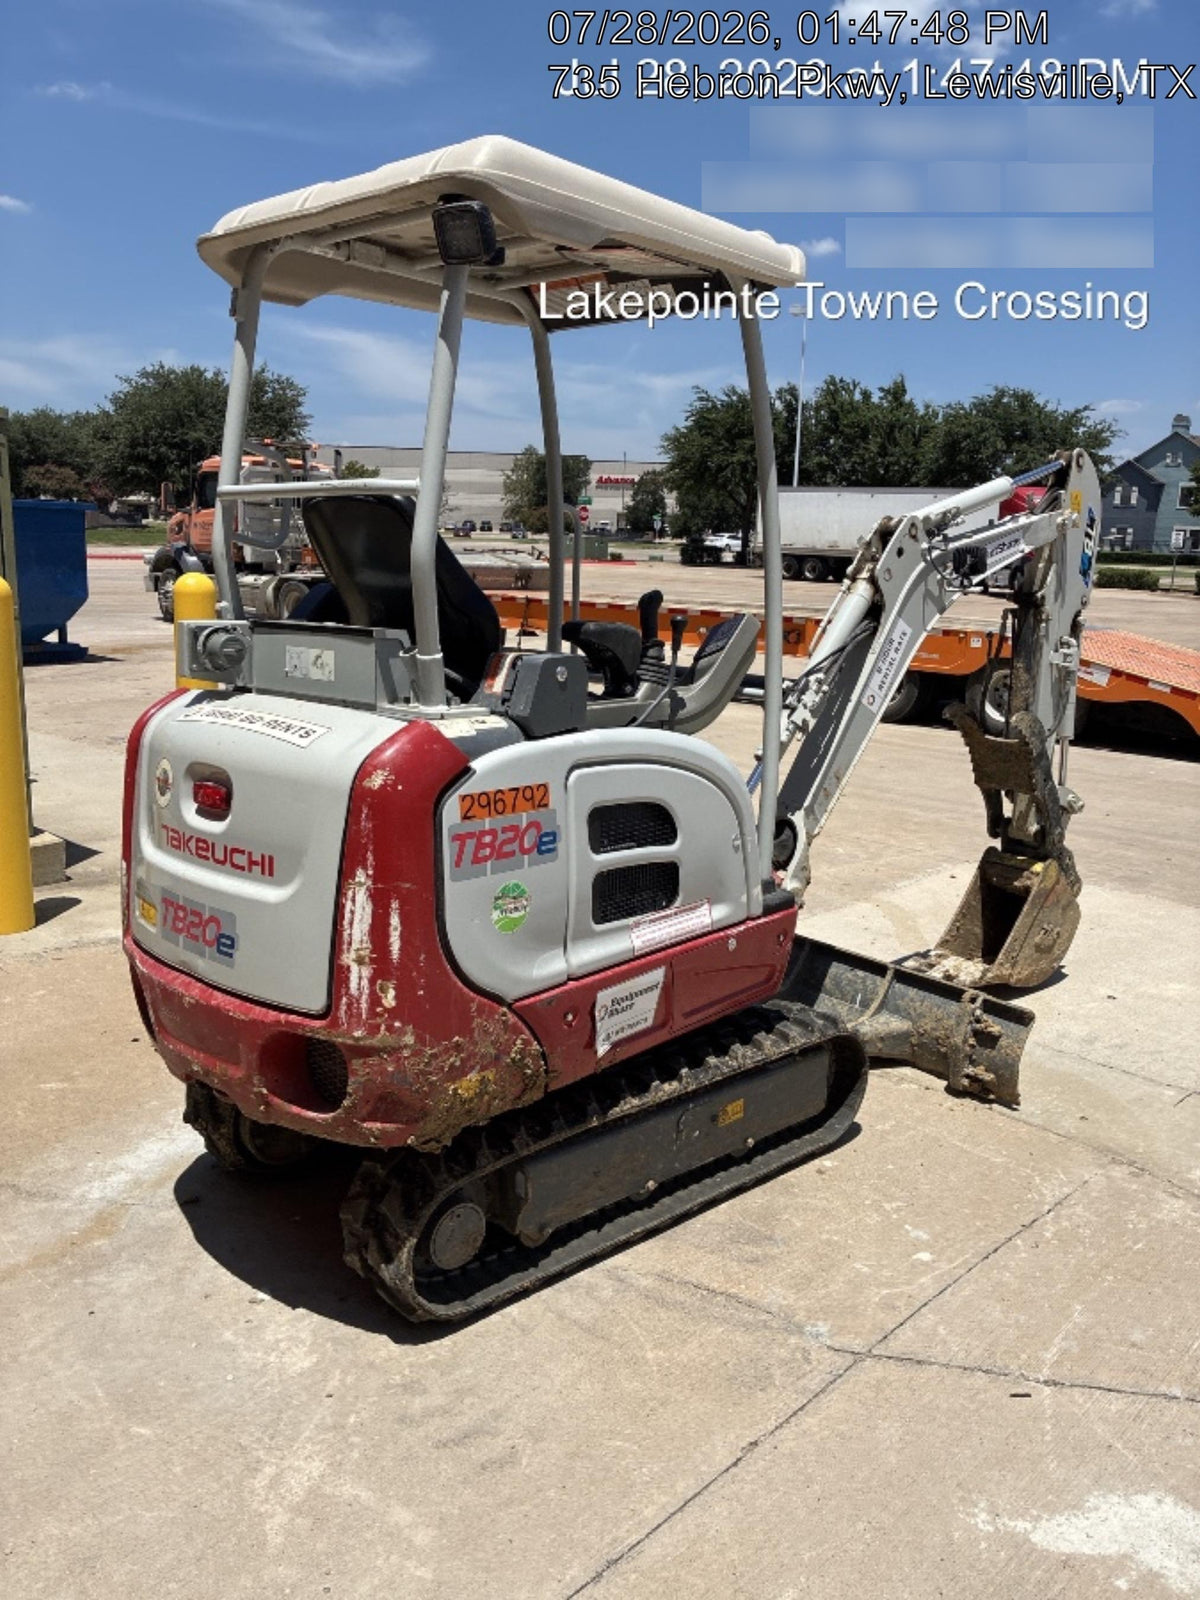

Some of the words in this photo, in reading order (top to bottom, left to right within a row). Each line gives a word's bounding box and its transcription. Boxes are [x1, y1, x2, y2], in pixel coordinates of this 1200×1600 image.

[461, 783, 550, 821] 296792
[450, 820, 558, 869] TB20e
[160, 895, 236, 960] TB20e
